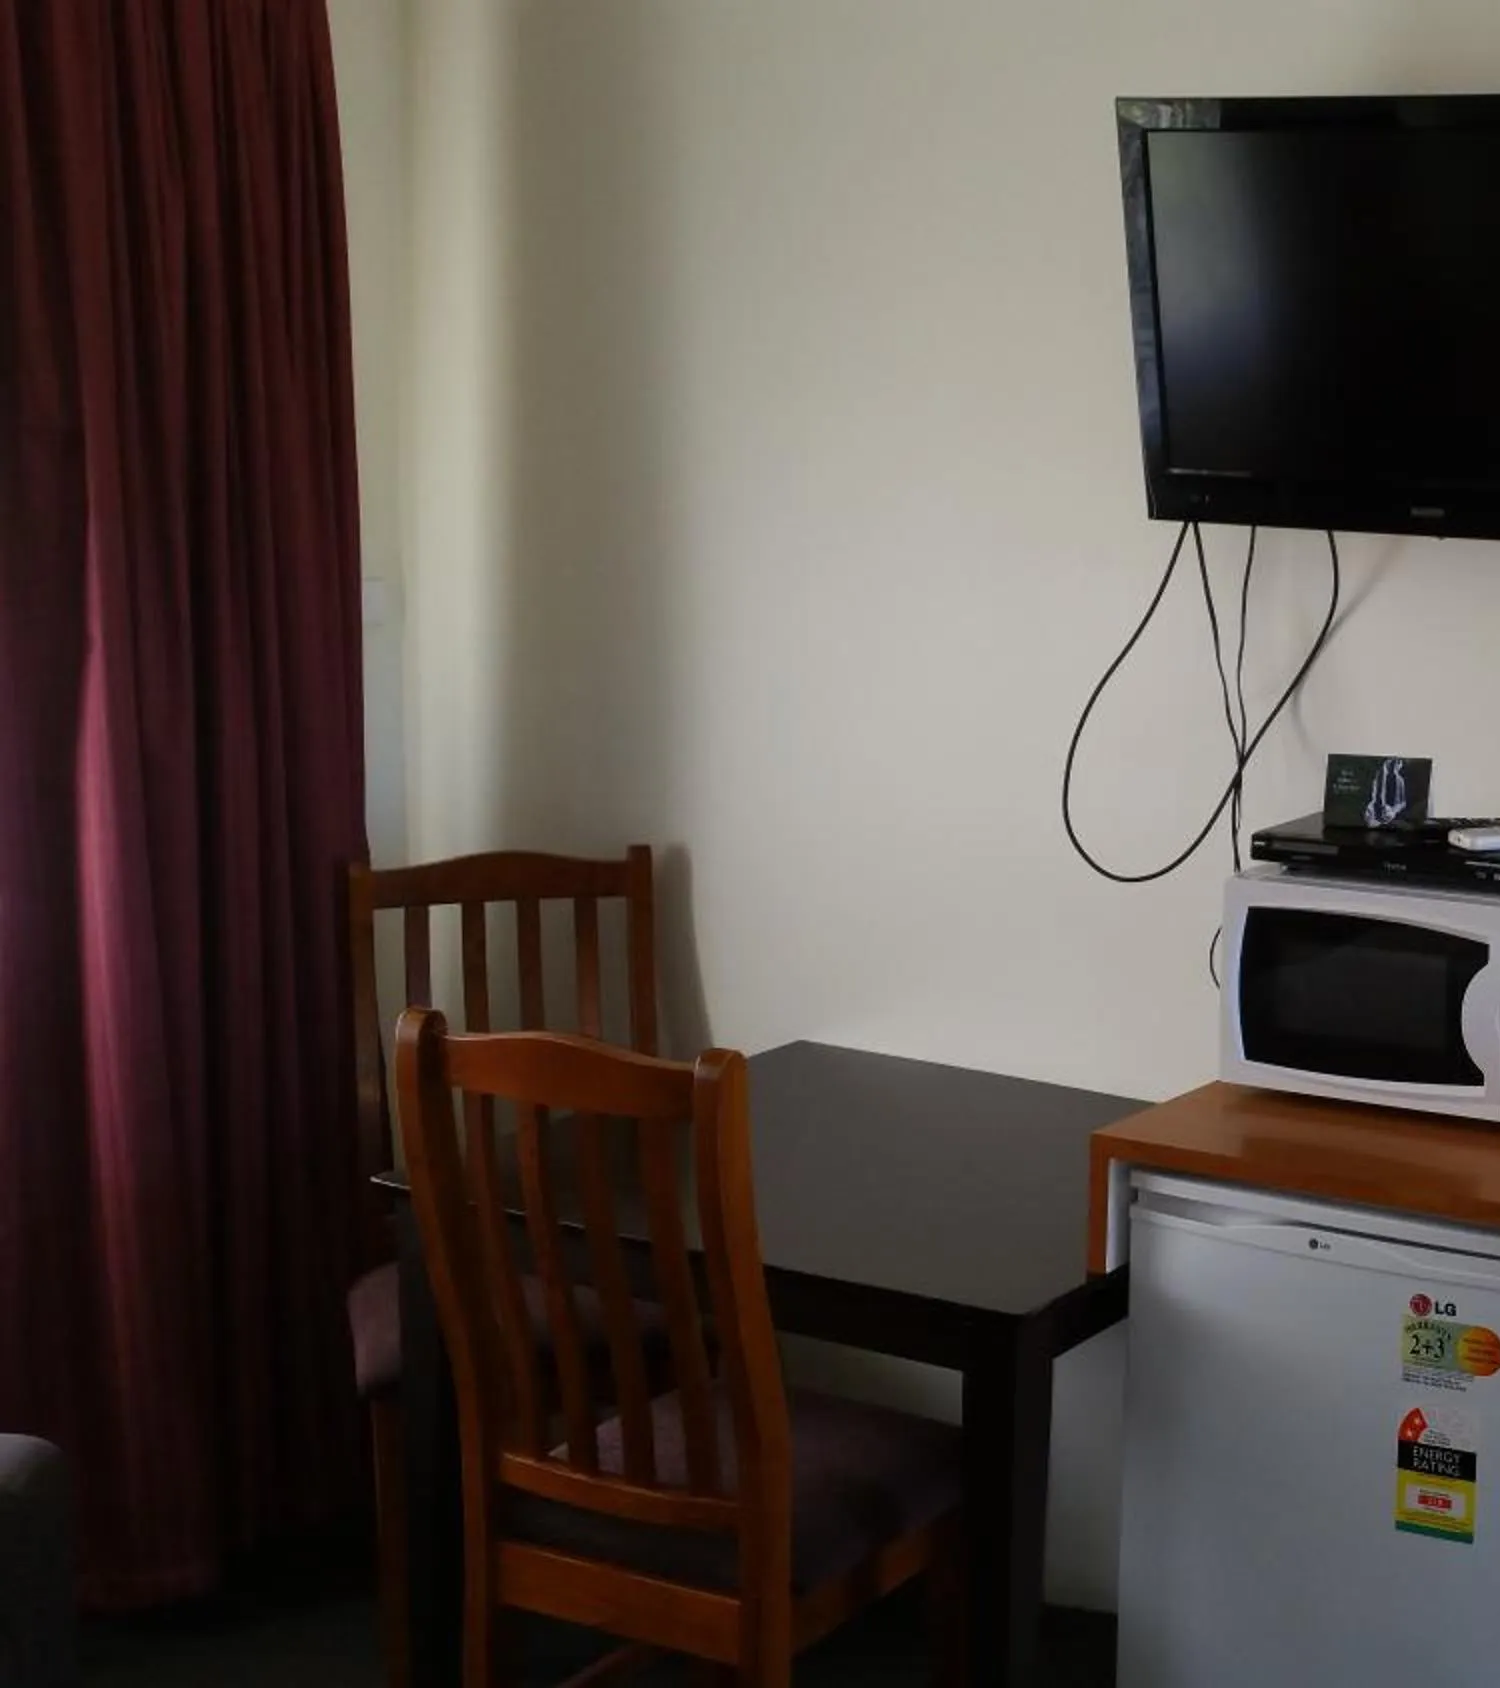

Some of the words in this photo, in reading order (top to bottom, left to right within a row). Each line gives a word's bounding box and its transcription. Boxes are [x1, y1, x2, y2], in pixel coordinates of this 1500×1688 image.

[1434, 1301, 1457, 1316] LG
[1412, 1445, 1462, 1465] ENERGY
[1412, 1457, 1462, 1477] RATING
